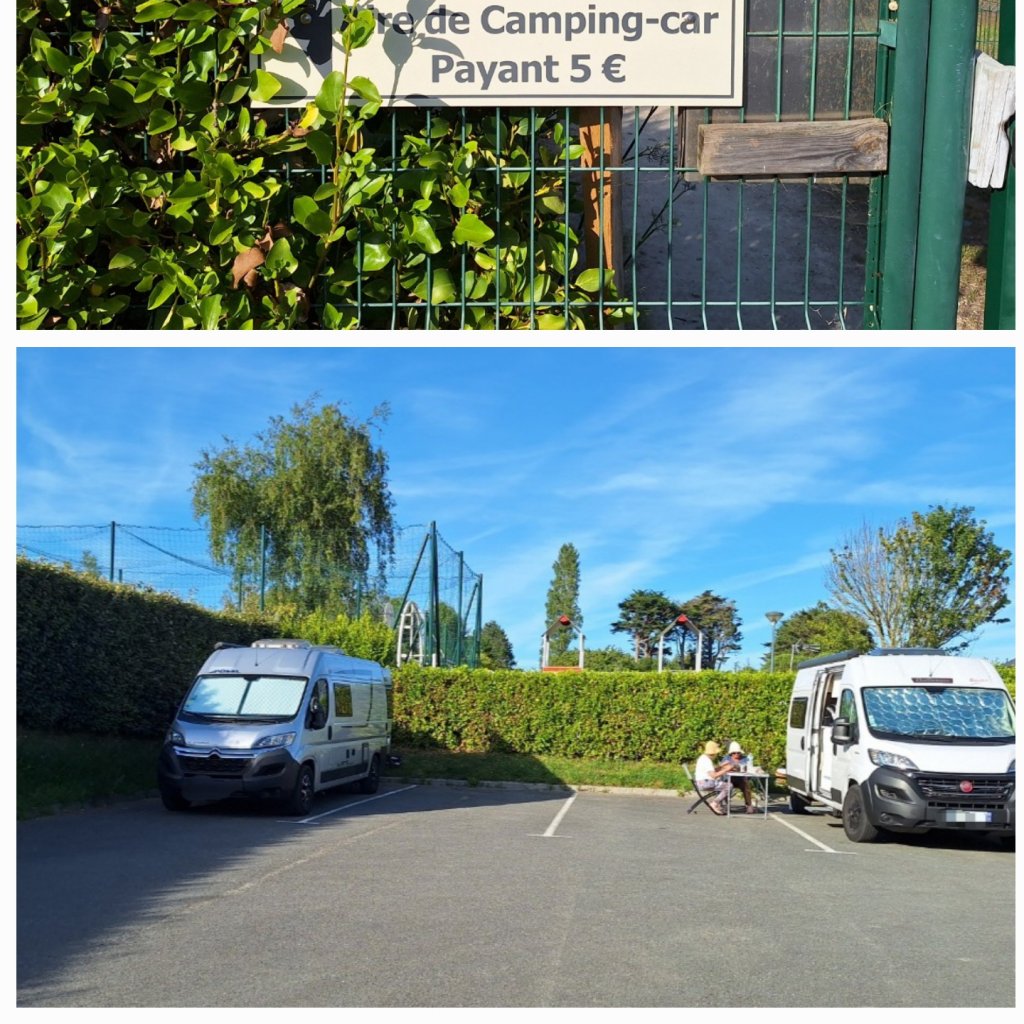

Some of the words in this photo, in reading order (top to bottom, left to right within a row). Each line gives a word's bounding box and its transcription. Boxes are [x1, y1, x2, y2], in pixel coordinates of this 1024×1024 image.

[425, 4, 470, 35] de
[480, 5, 720, 41] Camping-car
[431, 54, 561, 90] Payant
[570, 55, 592, 83] 5
[601, 54, 626, 84] €
